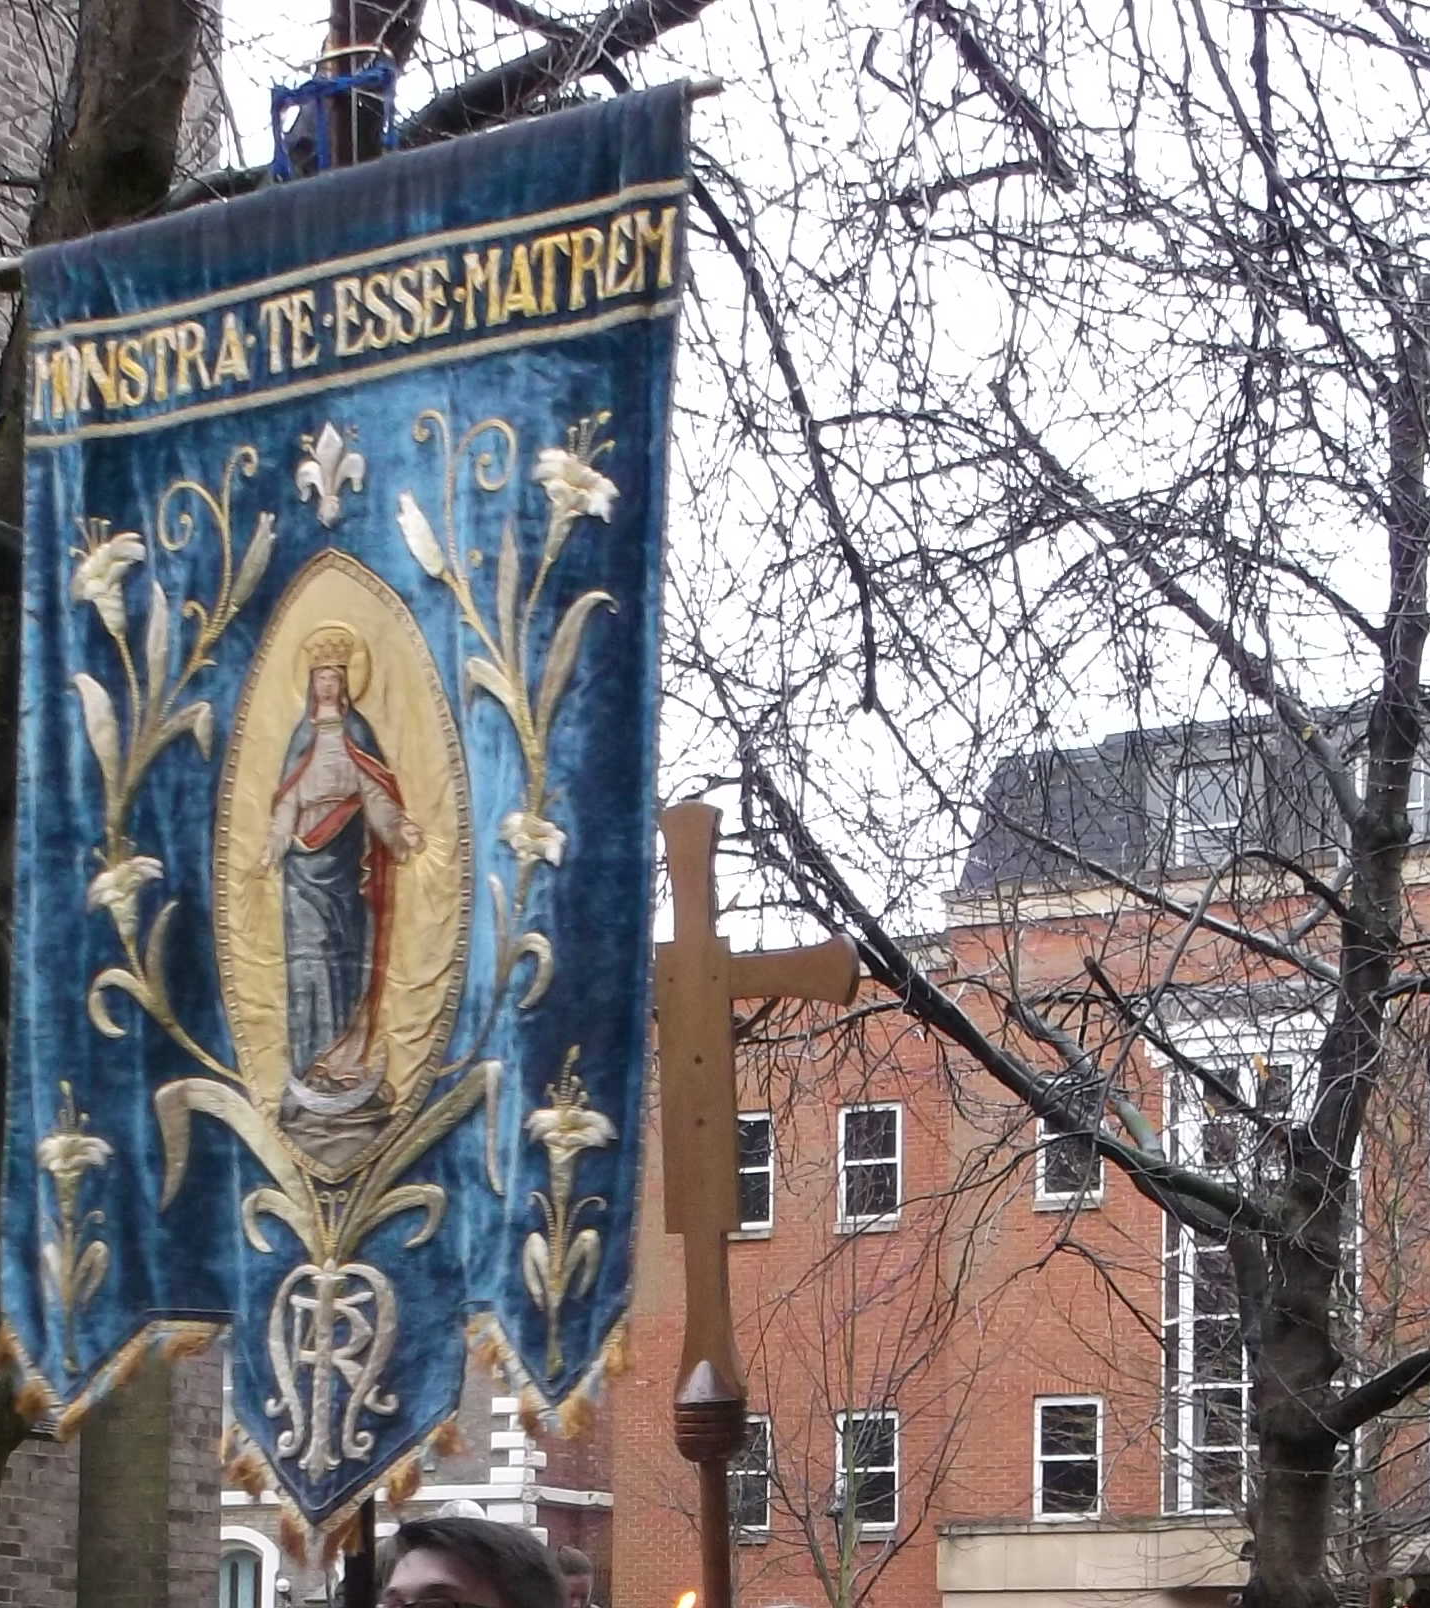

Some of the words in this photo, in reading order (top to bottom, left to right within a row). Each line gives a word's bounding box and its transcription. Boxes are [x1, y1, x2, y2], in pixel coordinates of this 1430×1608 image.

[259, 289, 321, 375] TE
[334, 258, 453, 358] ESSE
[462, 206, 678, 331] MATREM
